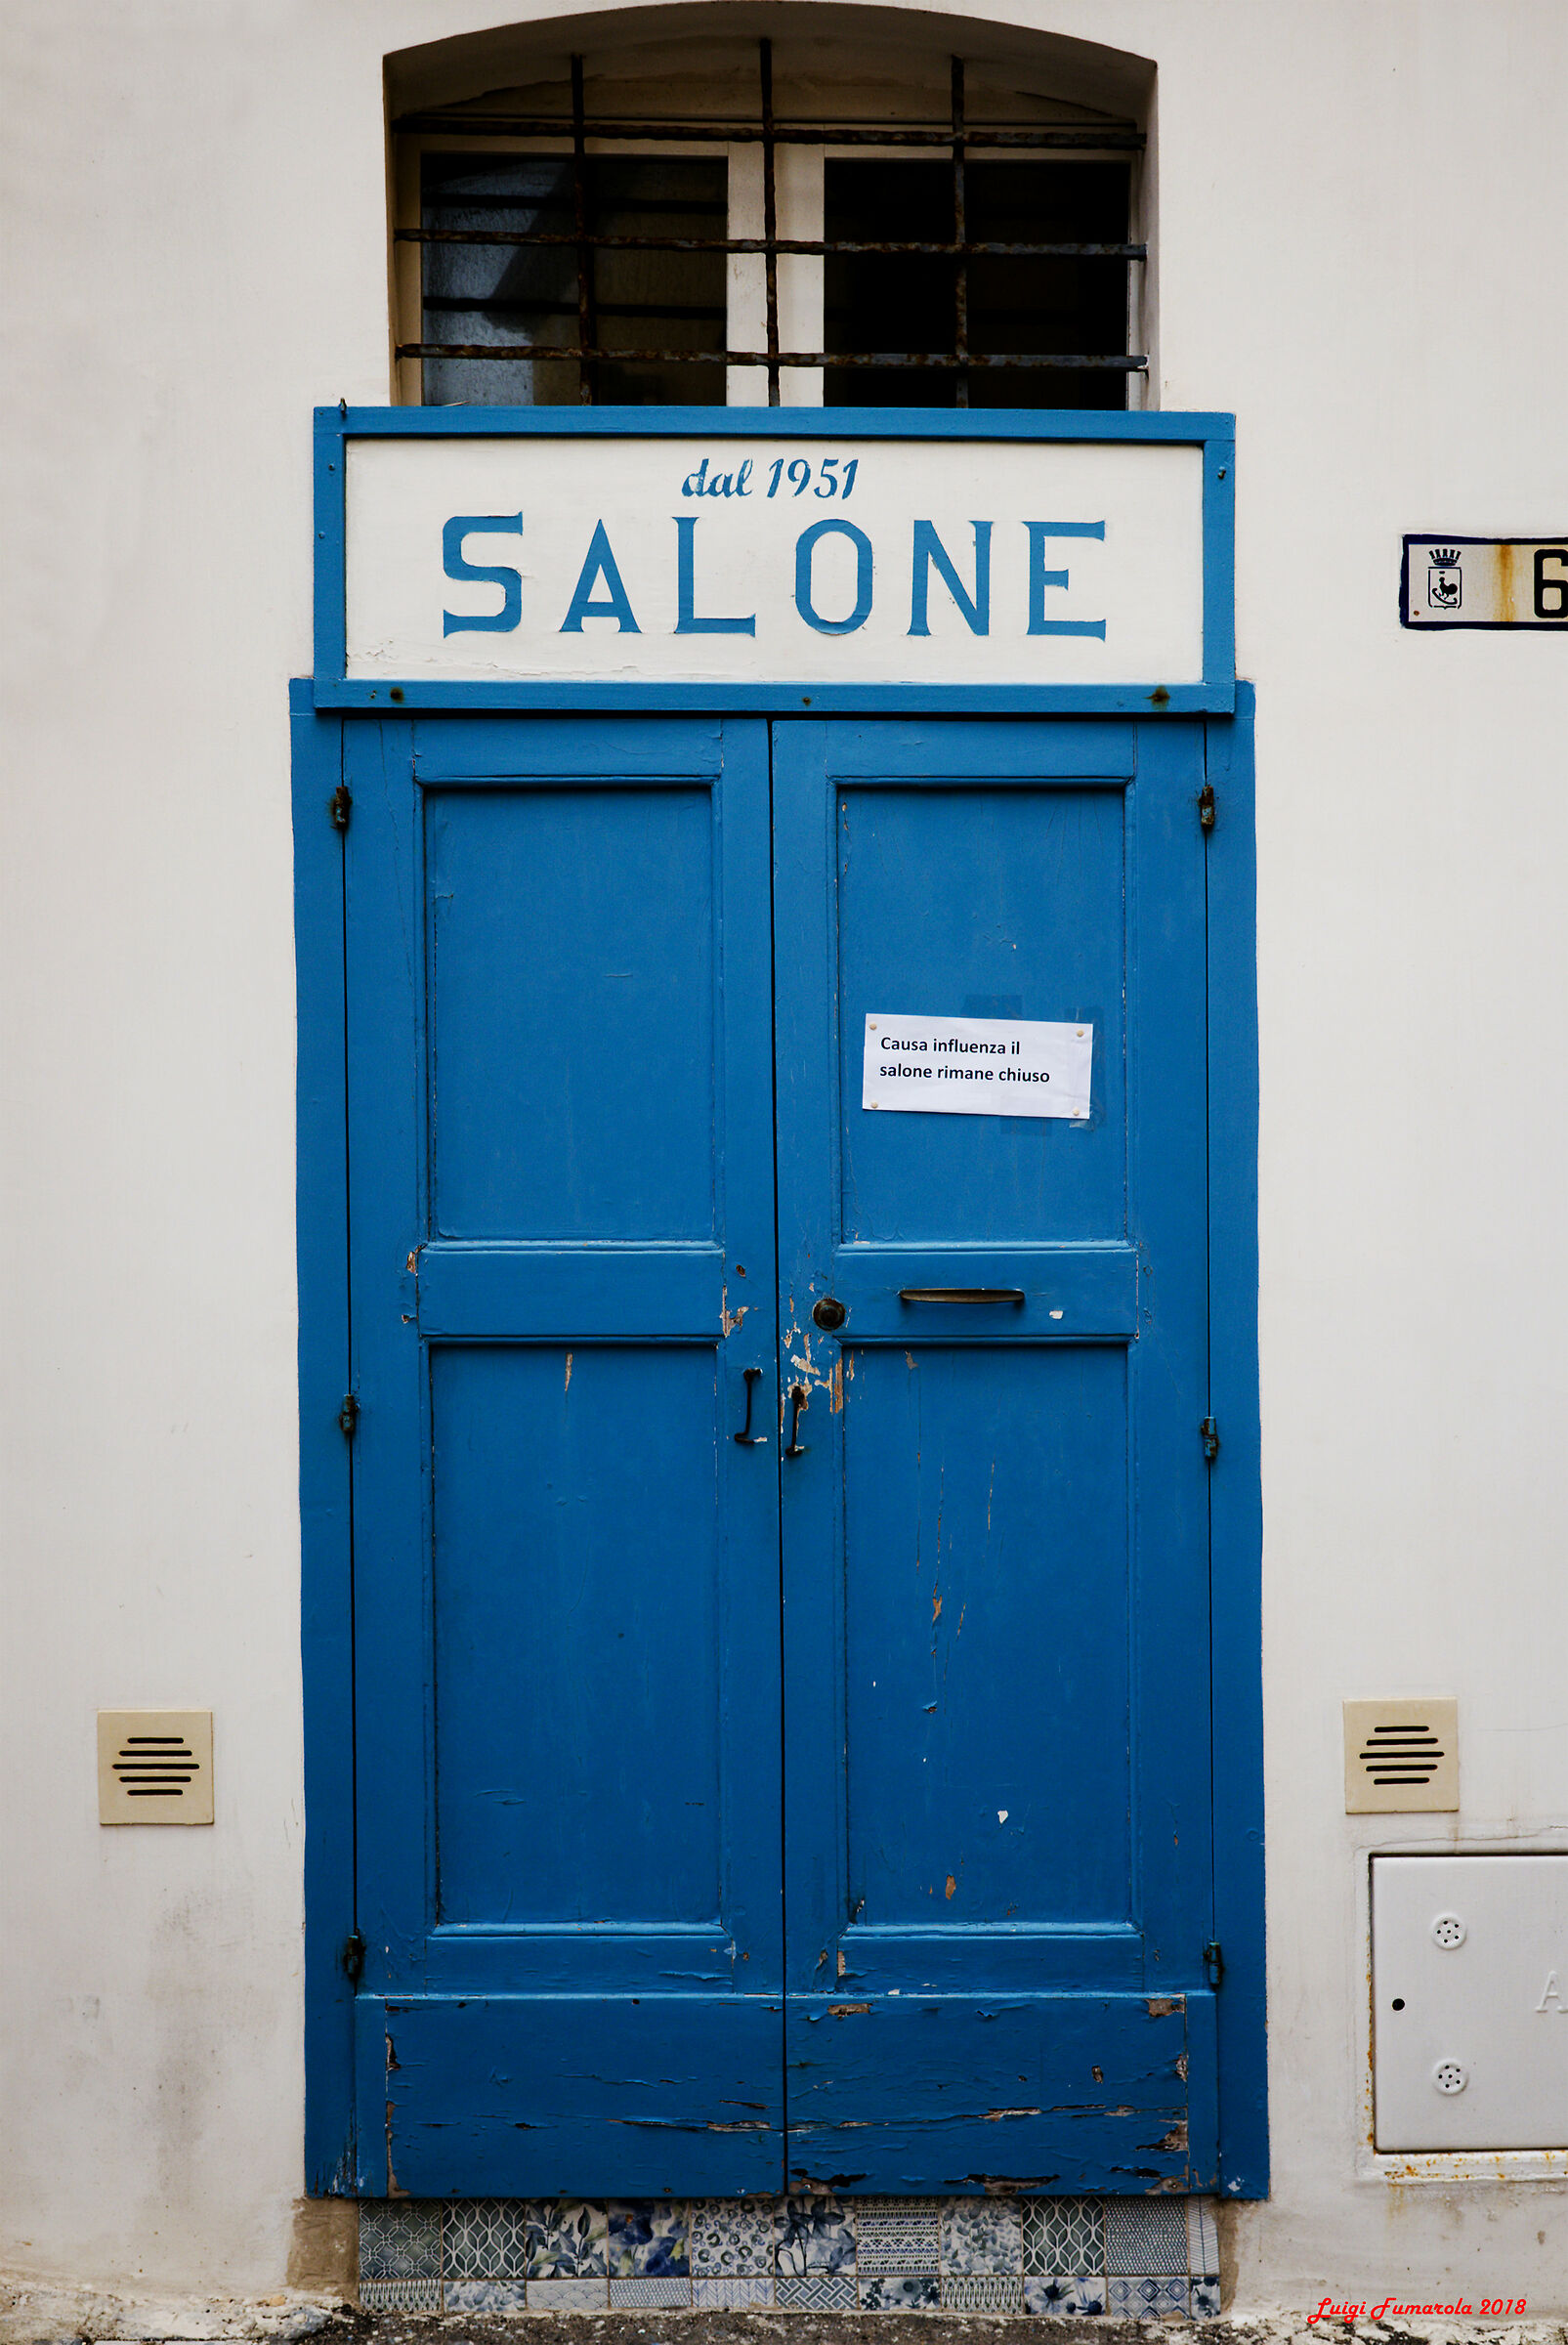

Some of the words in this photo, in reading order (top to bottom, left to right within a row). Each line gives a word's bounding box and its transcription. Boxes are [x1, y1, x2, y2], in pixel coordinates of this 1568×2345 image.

[682, 458, 753, 497] dal
[767, 458, 859, 499] 1951
[443, 511, 1106, 640] SALONE
[1534, 549, 1568, 618] 6
[880, 1037, 928, 1051] Causa
[933, 1039, 1006, 1054] influenza
[1011, 1042, 1020, 1054] il
[879, 1063, 933, 1079] salone
[937, 1065, 994, 1081] rimane
[998, 1068, 1050, 1083] chiuso
